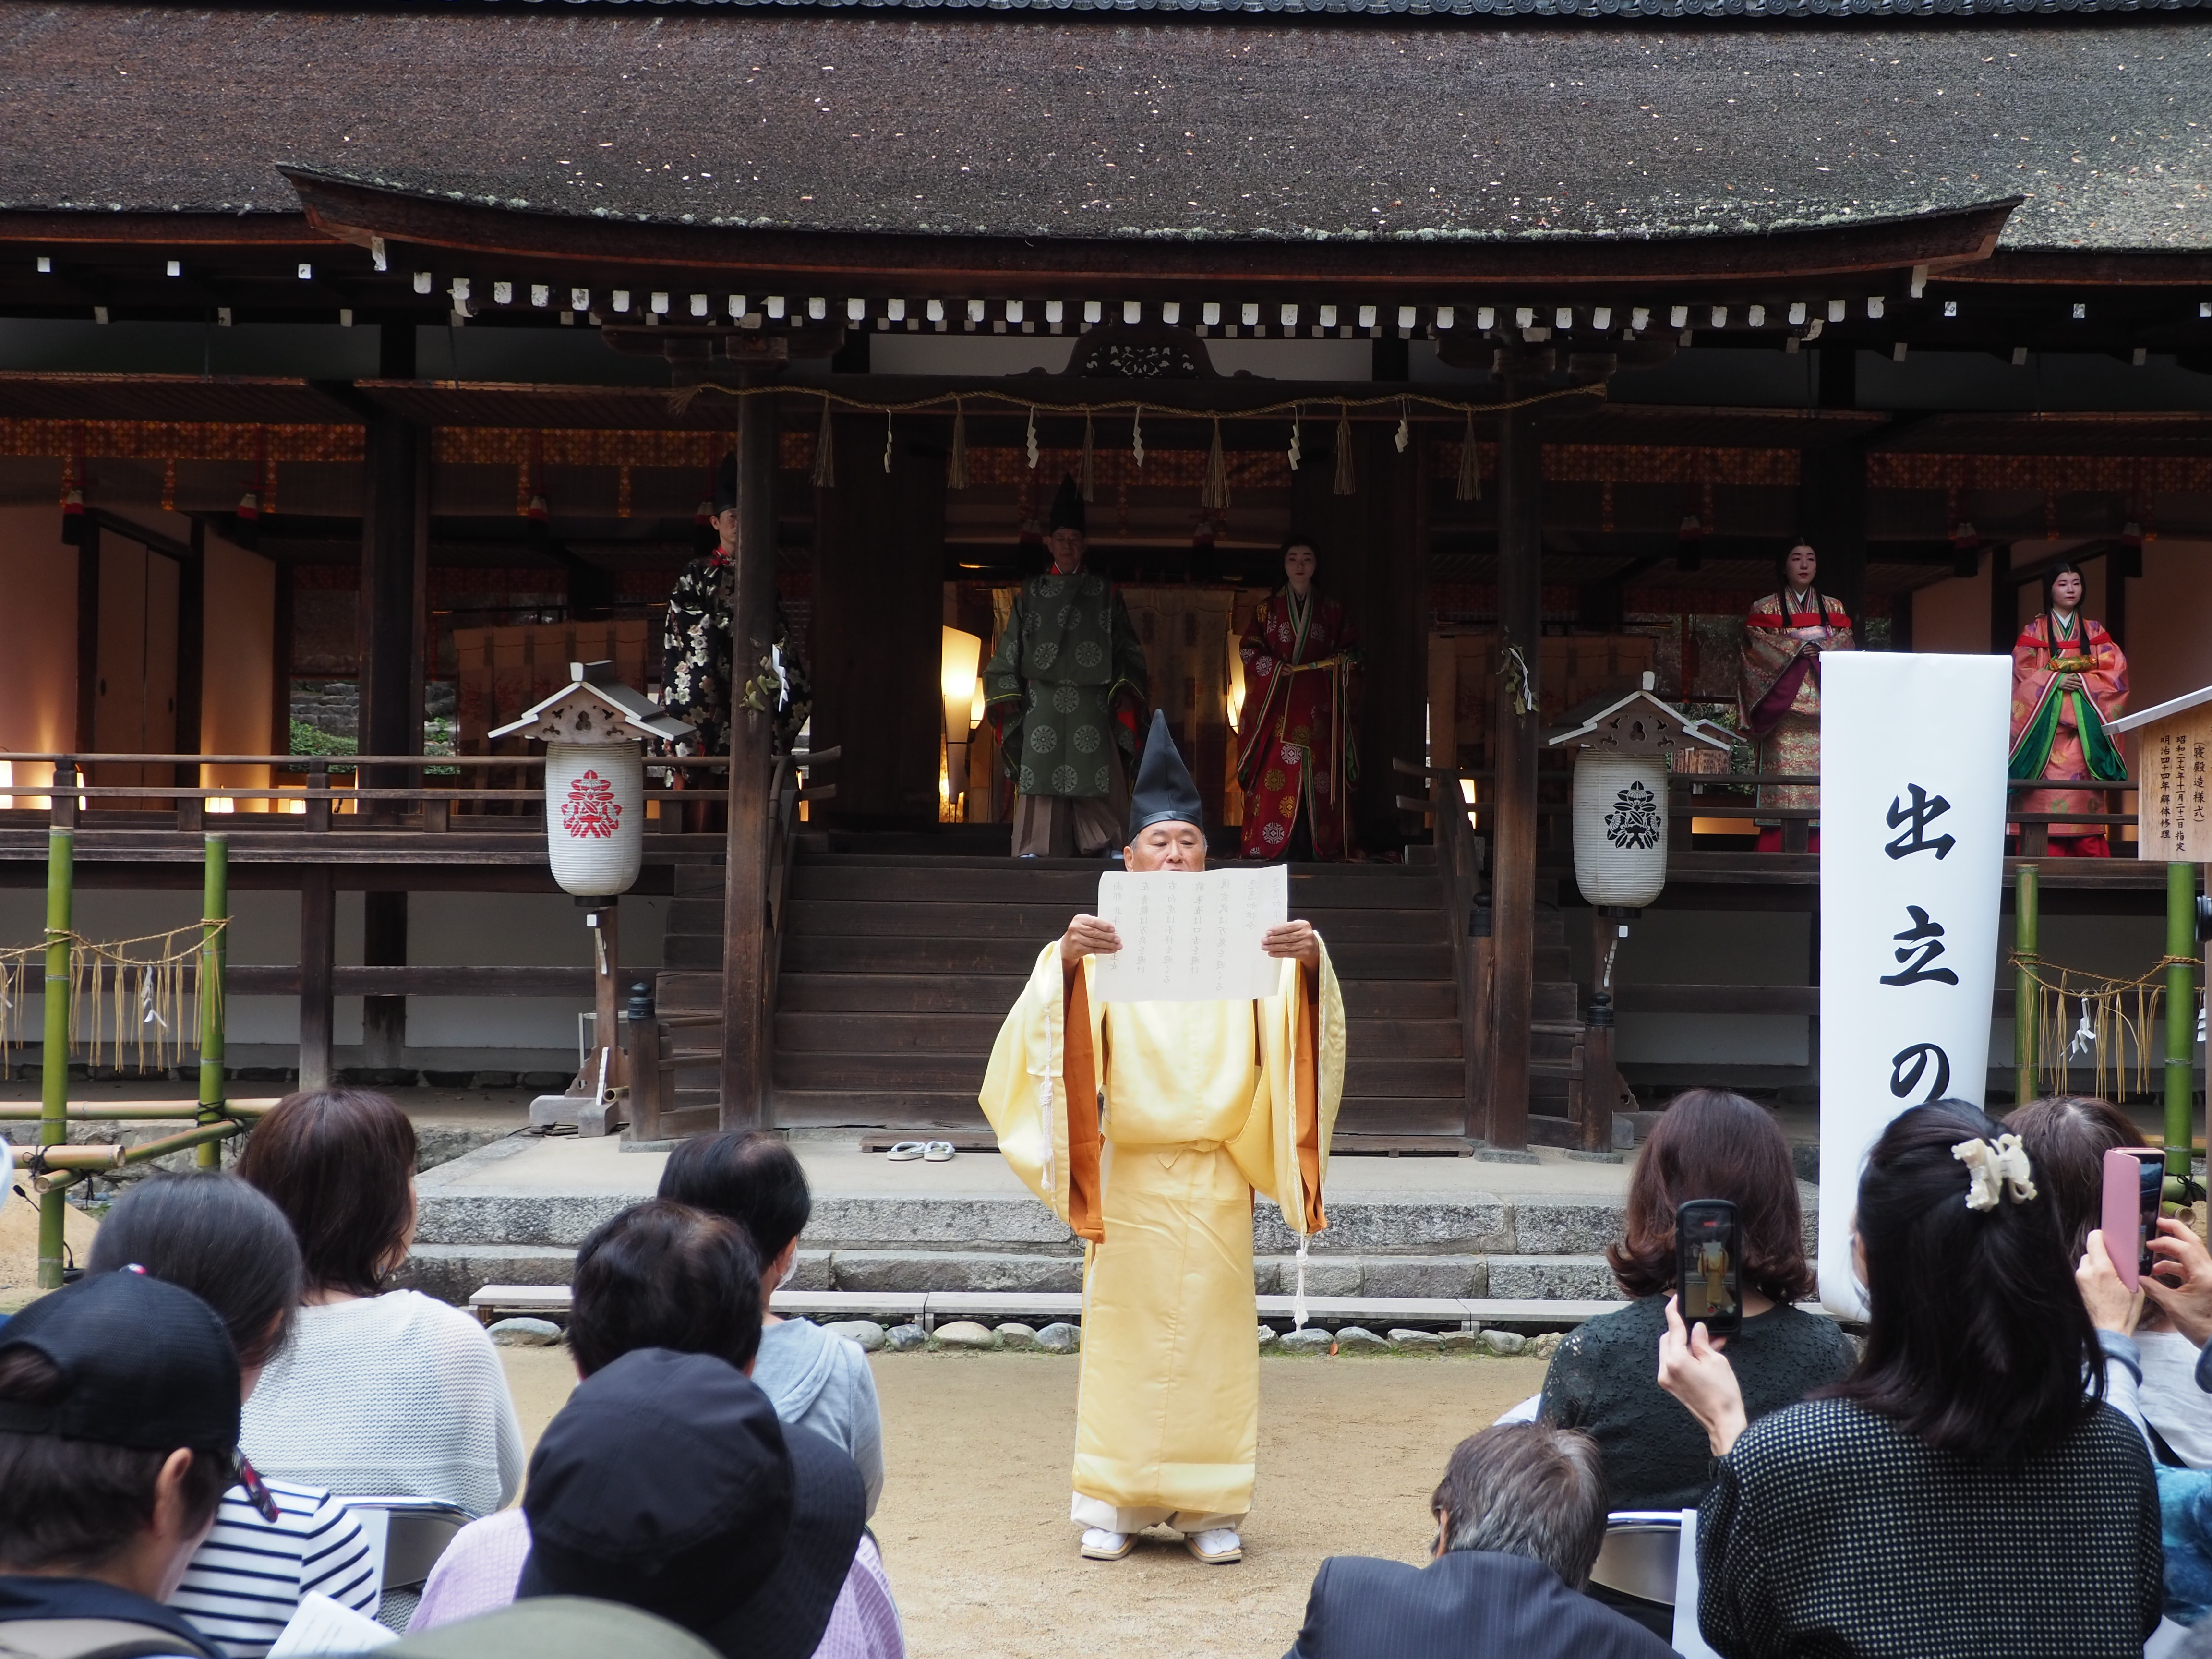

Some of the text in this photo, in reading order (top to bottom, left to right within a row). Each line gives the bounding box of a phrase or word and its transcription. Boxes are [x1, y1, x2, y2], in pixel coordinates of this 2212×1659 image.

[2160, 735, 2171, 839] 明治四十四年解体修理
[2175, 735, 2186, 851] 昭和二十七年十一月二十二日指定
[1879, 782, 1959, 1103] 出立の
